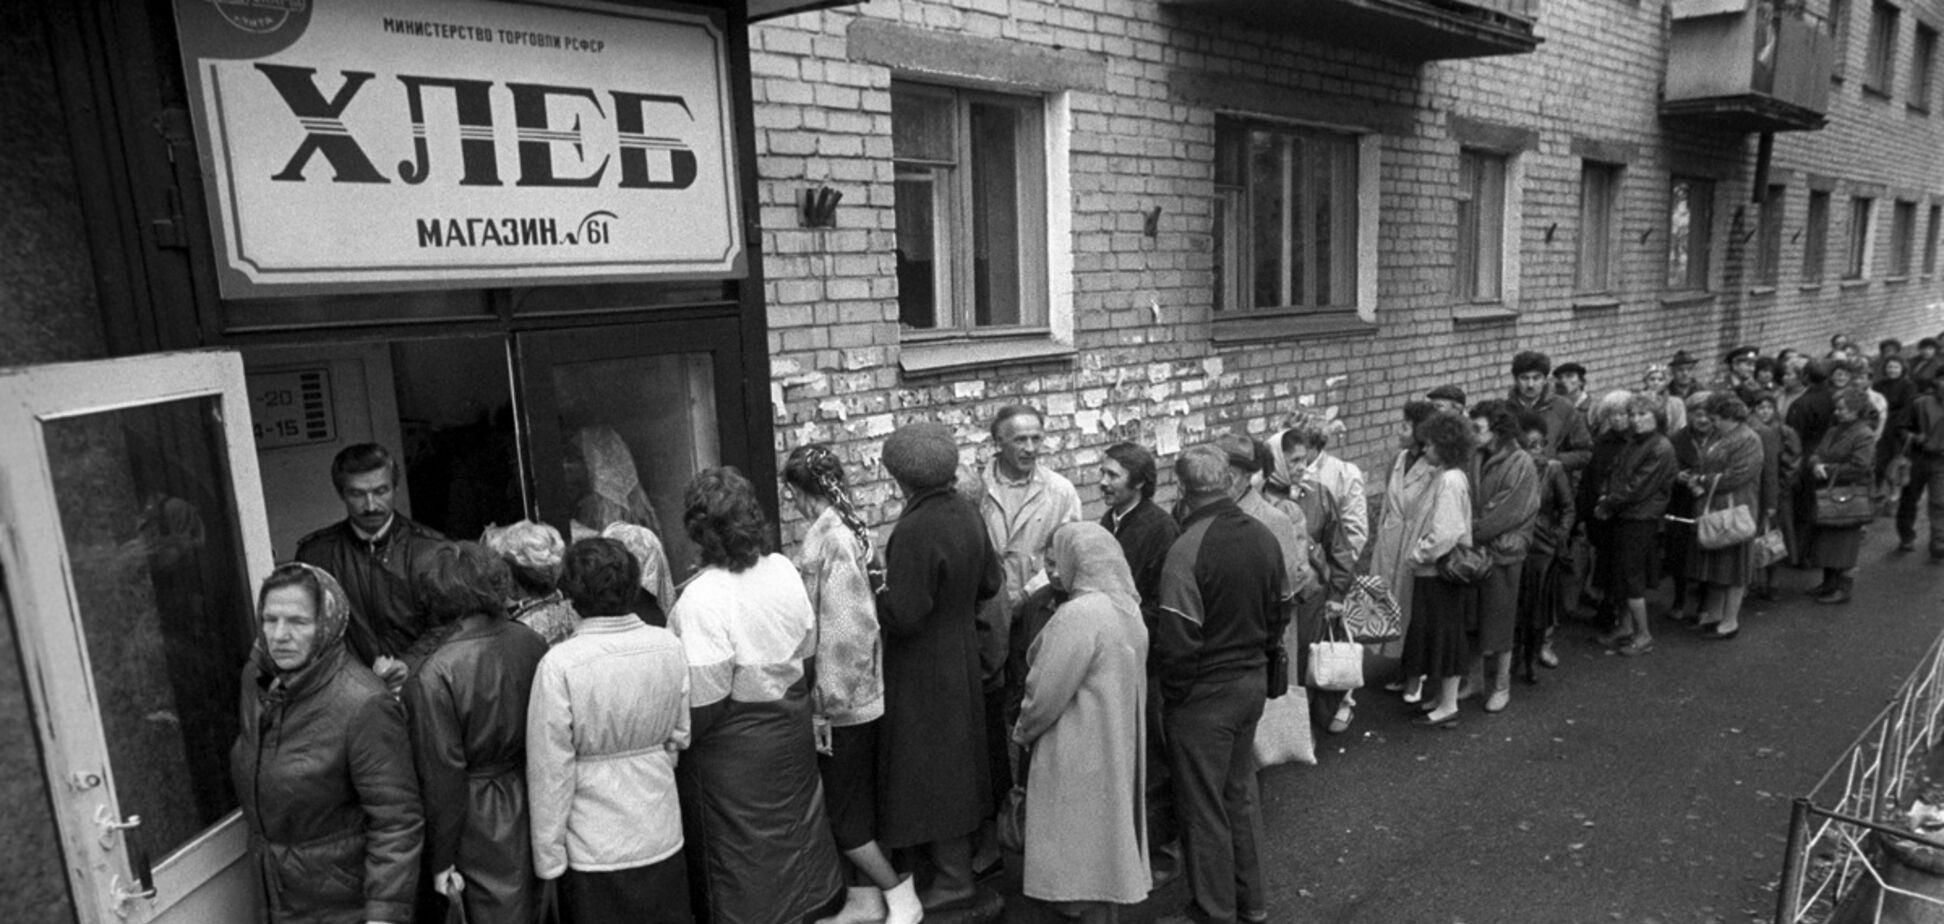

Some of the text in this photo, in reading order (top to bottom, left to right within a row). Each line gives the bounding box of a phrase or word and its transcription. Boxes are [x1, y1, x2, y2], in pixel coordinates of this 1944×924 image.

[382, 17, 493, 43] МИНИСТЕРСТВО
[564, 36, 605, 53] РСФСР
[253, 62, 698, 190] ХЛЕБ
[416, 218, 558, 248] МАГАЗИН
